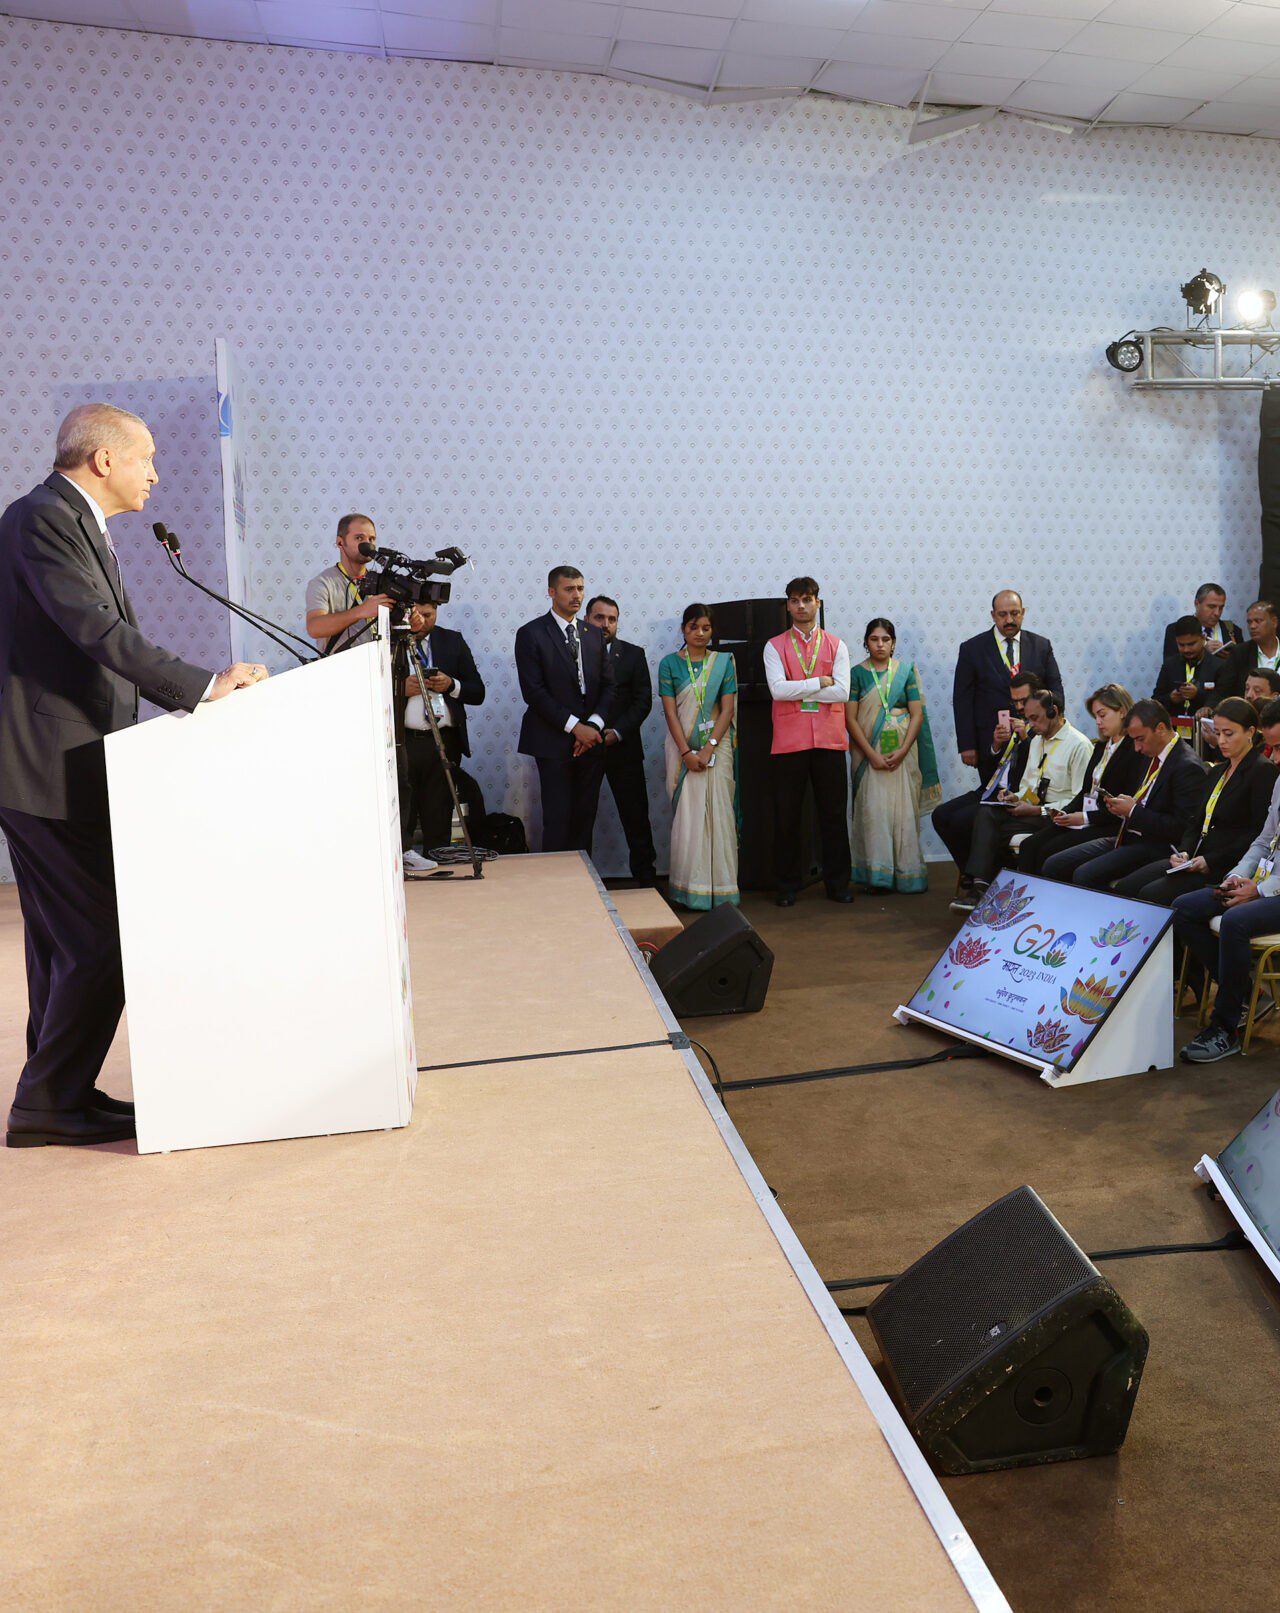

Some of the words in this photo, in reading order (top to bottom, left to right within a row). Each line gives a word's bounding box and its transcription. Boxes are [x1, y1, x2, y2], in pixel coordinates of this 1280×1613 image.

[1013, 924, 1077, 968] G20
[1019, 967, 1036, 981] 2023
[1036, 971, 1057, 985] INDIA
